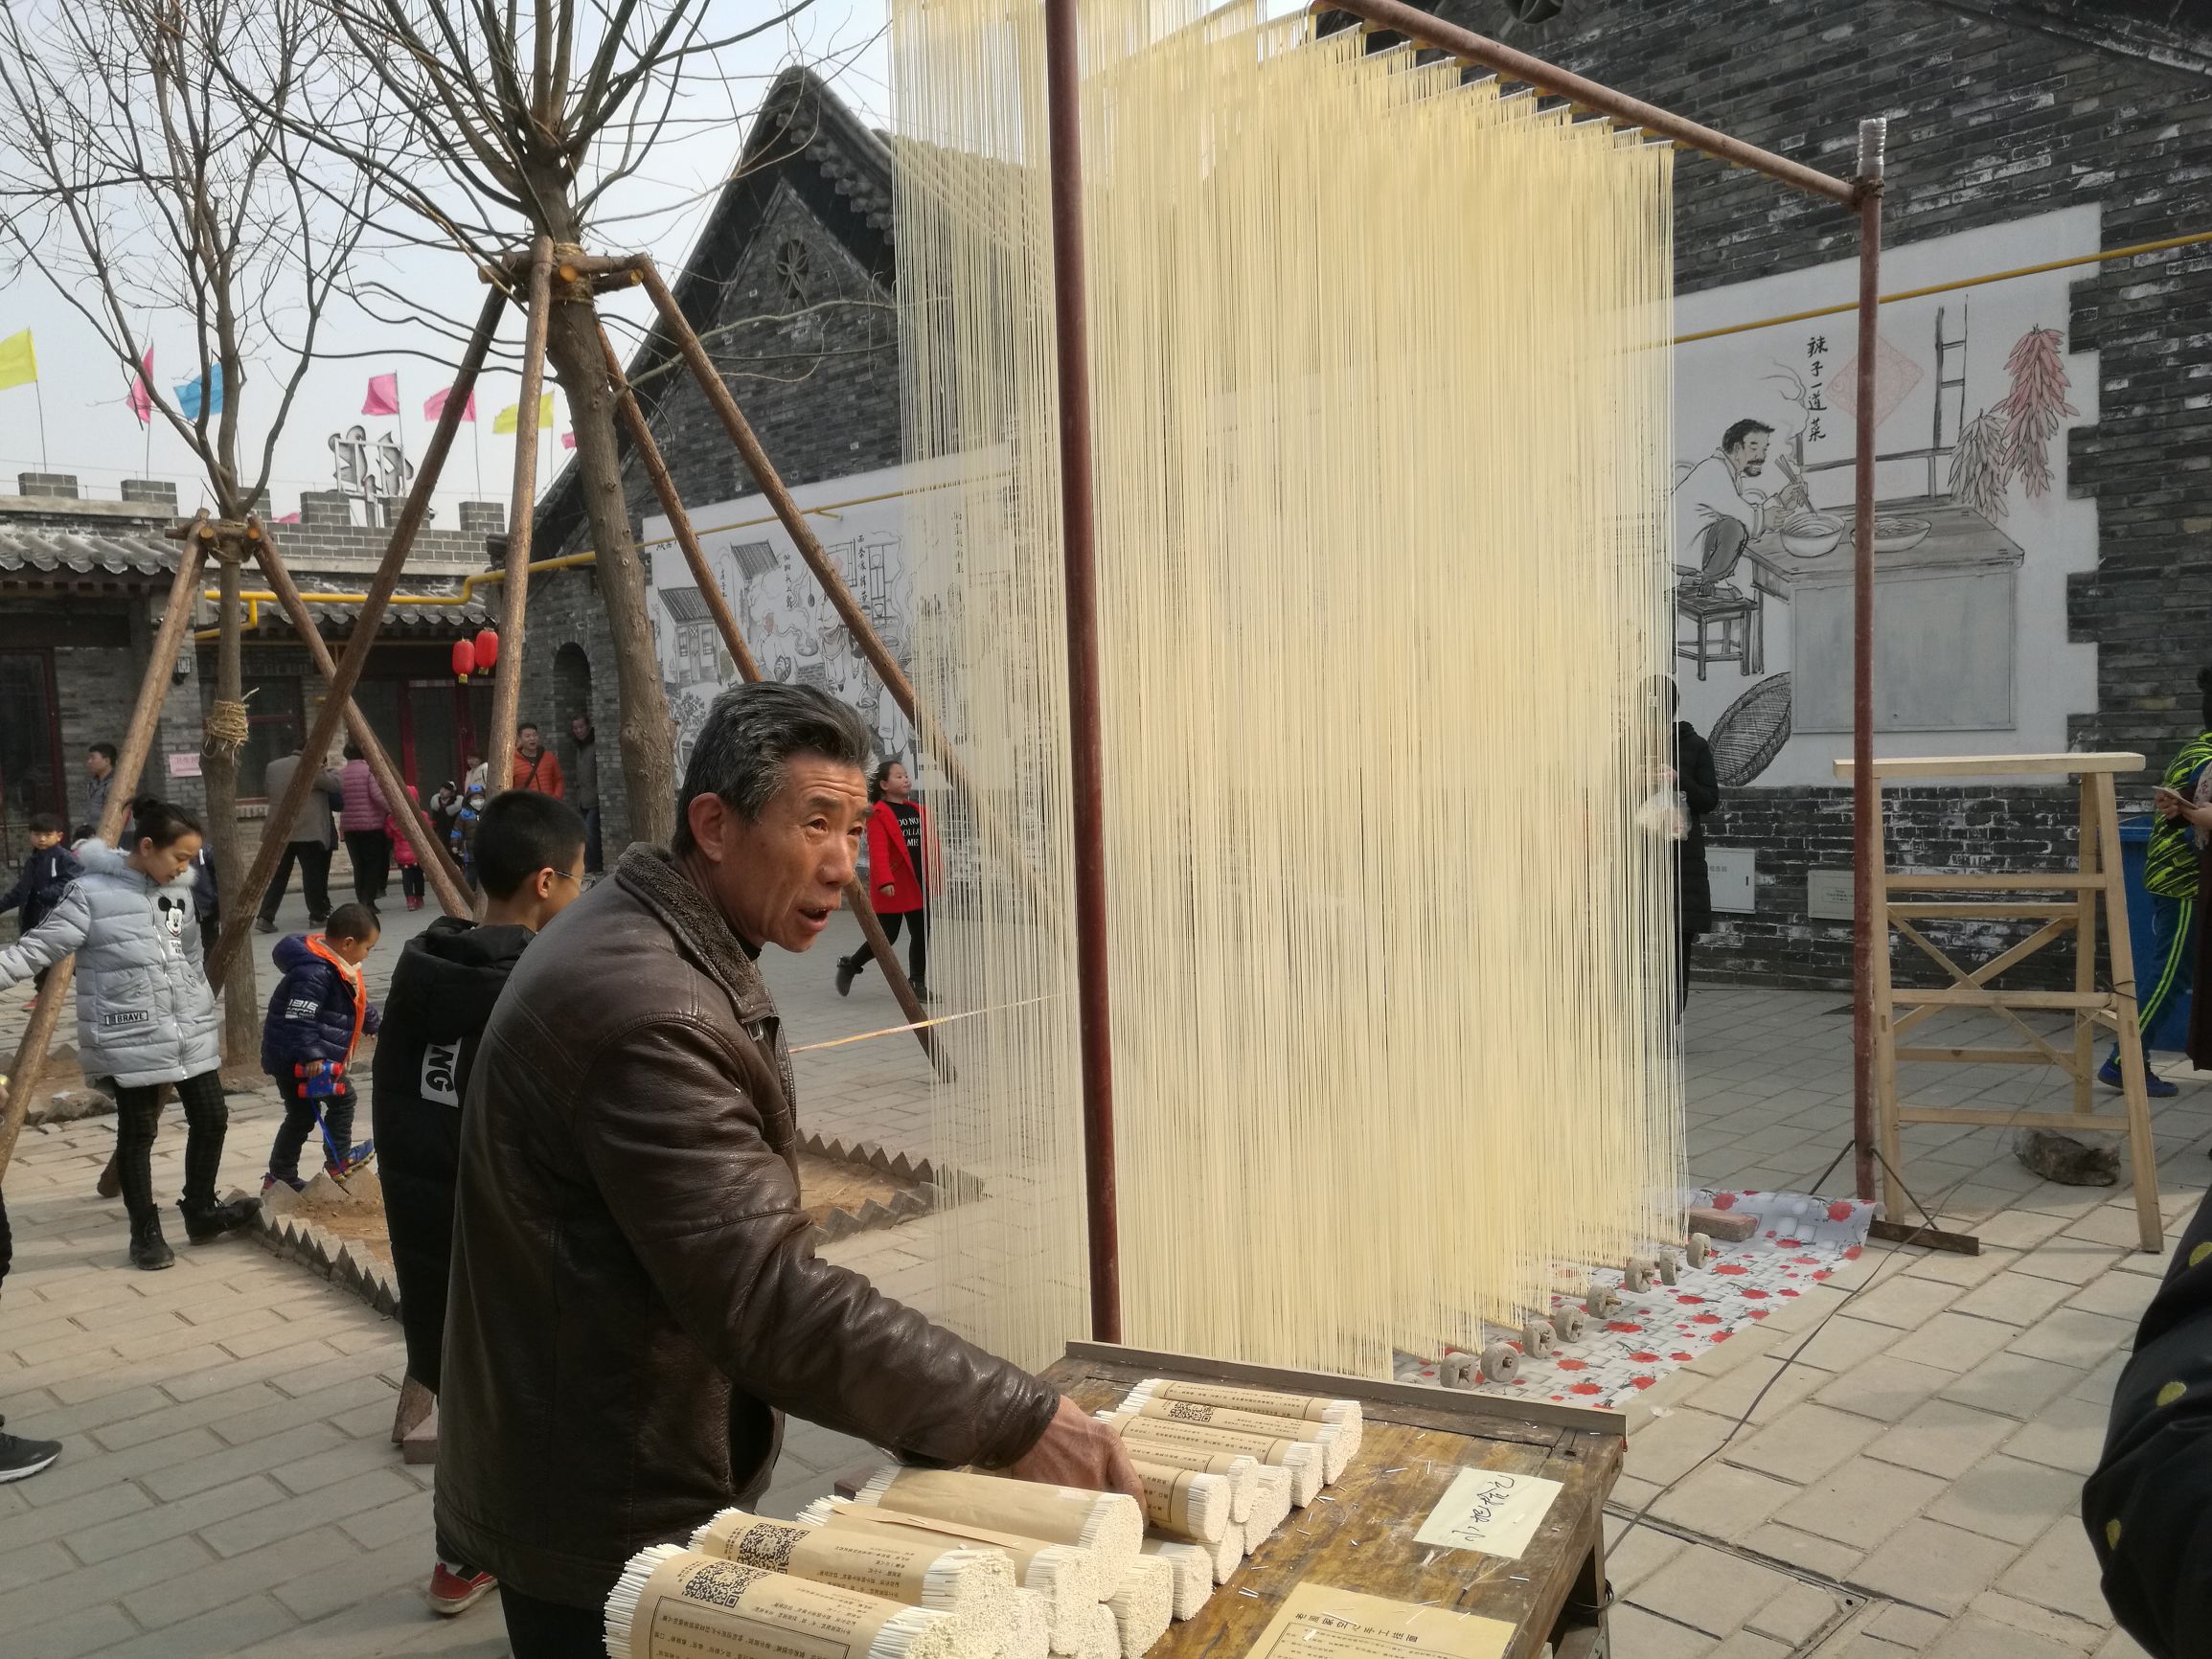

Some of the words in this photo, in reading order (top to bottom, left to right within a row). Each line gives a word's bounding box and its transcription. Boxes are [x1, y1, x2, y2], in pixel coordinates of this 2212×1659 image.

[1807, 335, 1829, 443] 辣子一道菜
[909, 816, 920, 826] NO
[117, 1011, 146, 1023] BRAVE
